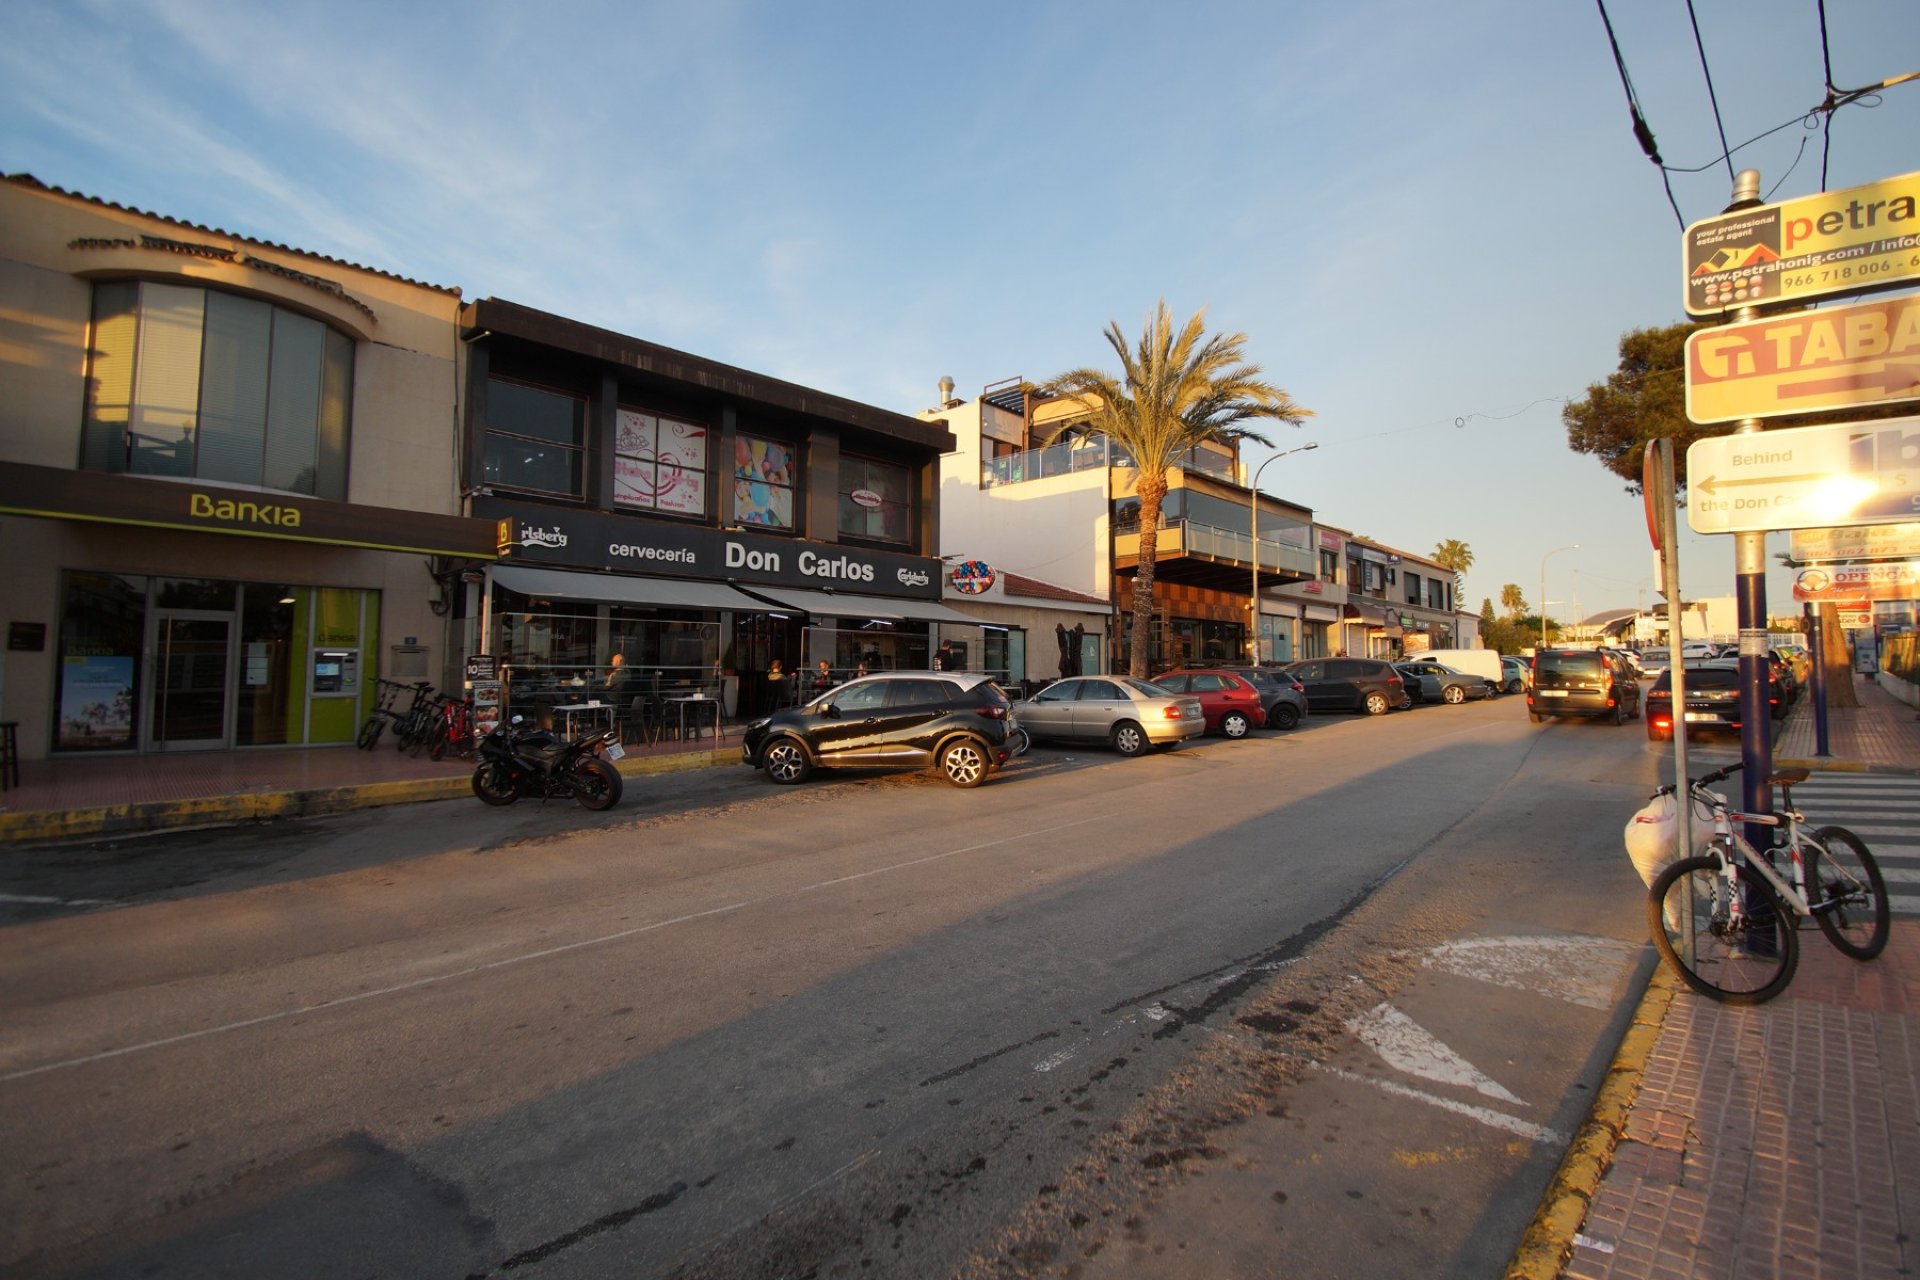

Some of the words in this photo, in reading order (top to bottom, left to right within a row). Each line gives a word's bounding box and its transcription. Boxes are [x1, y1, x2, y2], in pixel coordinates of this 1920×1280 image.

[1696, 227, 1716, 239] your
[1718, 215, 1775, 235] professional
[1786, 196, 1916, 250] petra
[1696, 234, 1724, 246] estate
[1726, 228, 1753, 241] agent
[1691, 247, 1865, 286] www.petrahonig.com
[1784, 275, 1814, 288] 966
[1822, 268, 1852, 281] 718
[1858, 261, 1890, 276] 006
[1732, 450, 1793, 466] Behind
[190, 493, 301, 528] Bankia
[1700, 499, 1729, 512] the
[1735, 497, 1768, 510] Don
[609, 540, 696, 564] cervecería
[725, 542, 780, 572] Don
[798, 551, 875, 581] Carlos
